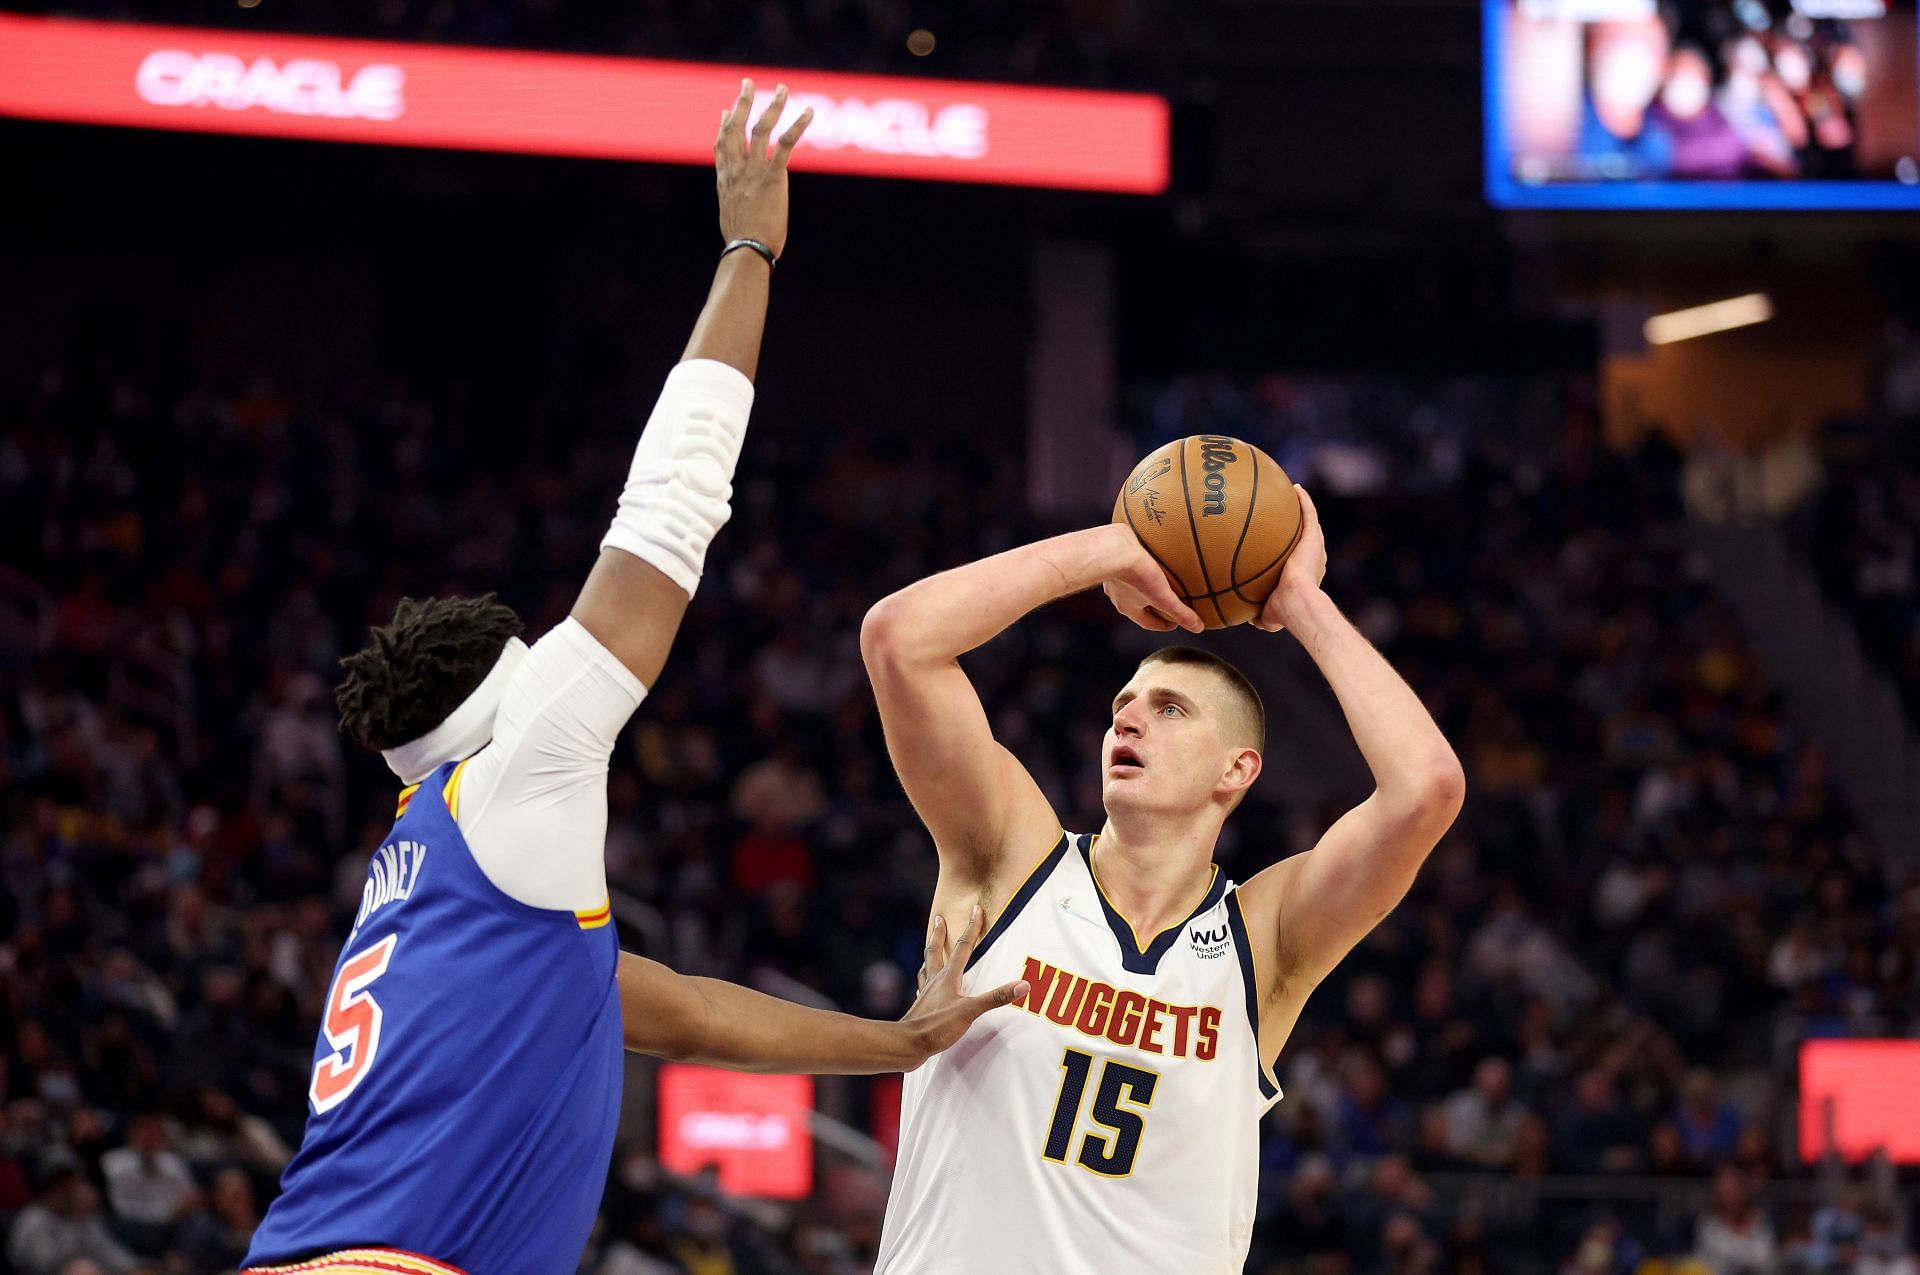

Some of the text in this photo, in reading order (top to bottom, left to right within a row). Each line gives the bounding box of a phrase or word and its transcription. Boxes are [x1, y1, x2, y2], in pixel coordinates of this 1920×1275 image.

[135, 49, 406, 120] ORACLE
[347, 841, 427, 950] OONEY
[1189, 924, 1228, 945] WU
[1190, 941, 1230, 954] Western
[1196, 950, 1226, 960] Union
[309, 933, 398, 1115] 5
[1012, 956, 1222, 1062] NUGGETS
[1041, 1045, 1161, 1179] 15
